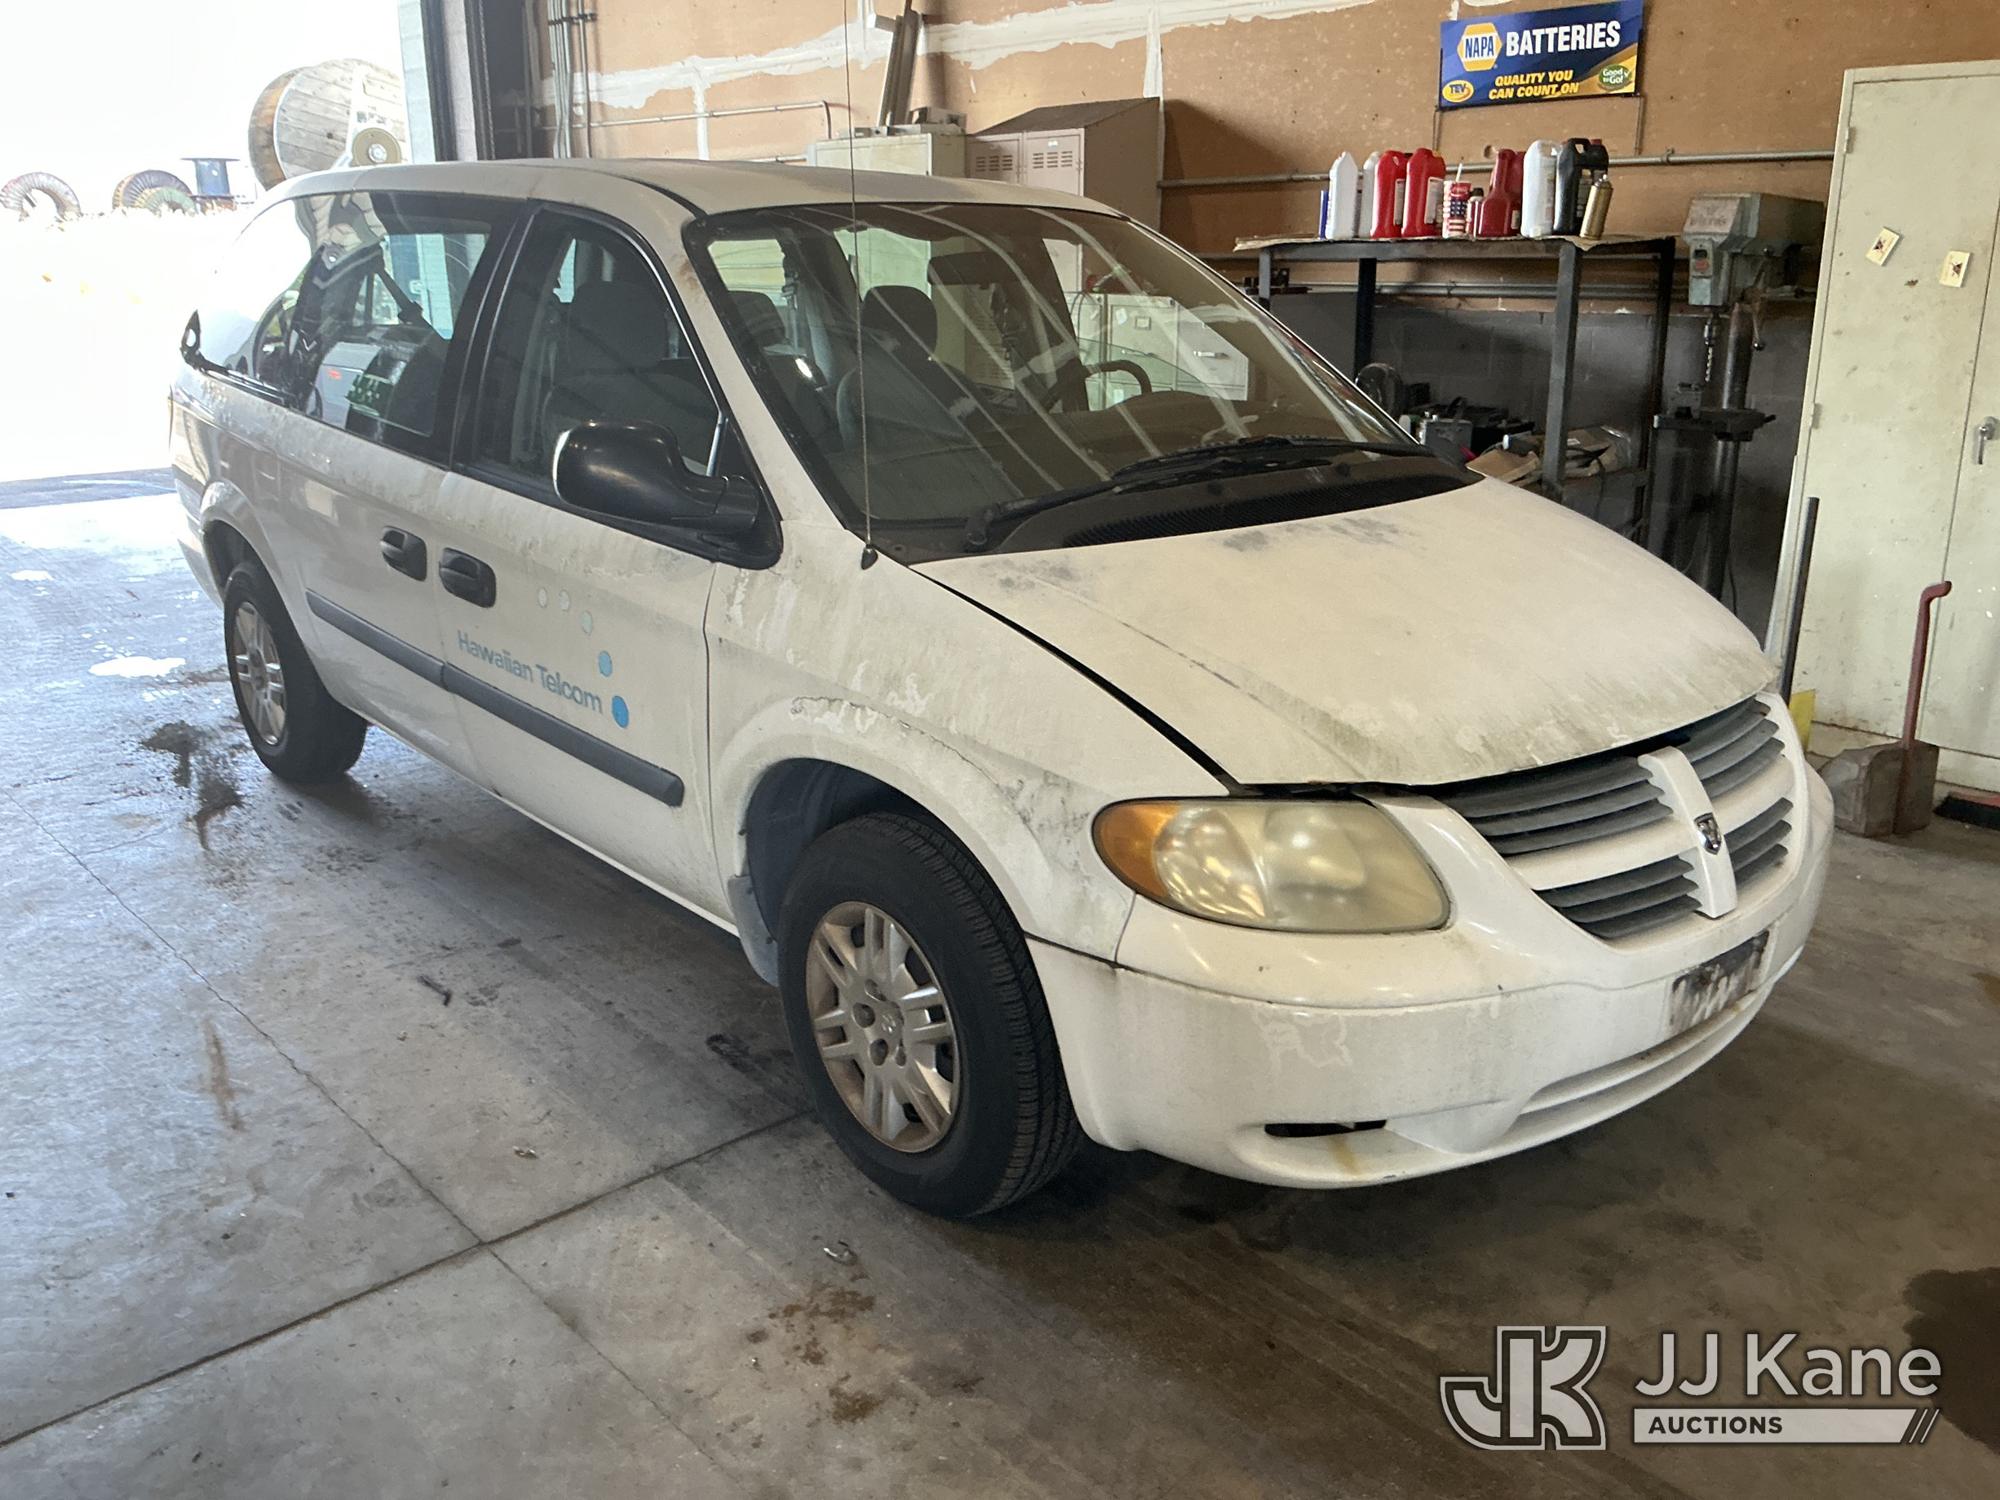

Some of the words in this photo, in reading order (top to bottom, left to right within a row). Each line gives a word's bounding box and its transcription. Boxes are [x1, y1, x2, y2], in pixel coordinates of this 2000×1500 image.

[1465, 35, 1494, 59] NAPA
[1506, 20, 1621, 57] BATTERIES
[1494, 71, 1546, 86] QUALITY
[1548, 69, 1574, 82] YOU
[1602, 68, 1623, 77] Good
[1609, 75, 1623, 84] Go!
[1489, 87, 1514, 100] CAN
[1516, 83, 1559, 98] COUNT
[1560, 82, 1580, 95] ON
[457, 629, 534, 683] Hawaiian
[535, 663, 603, 714] Telcom
